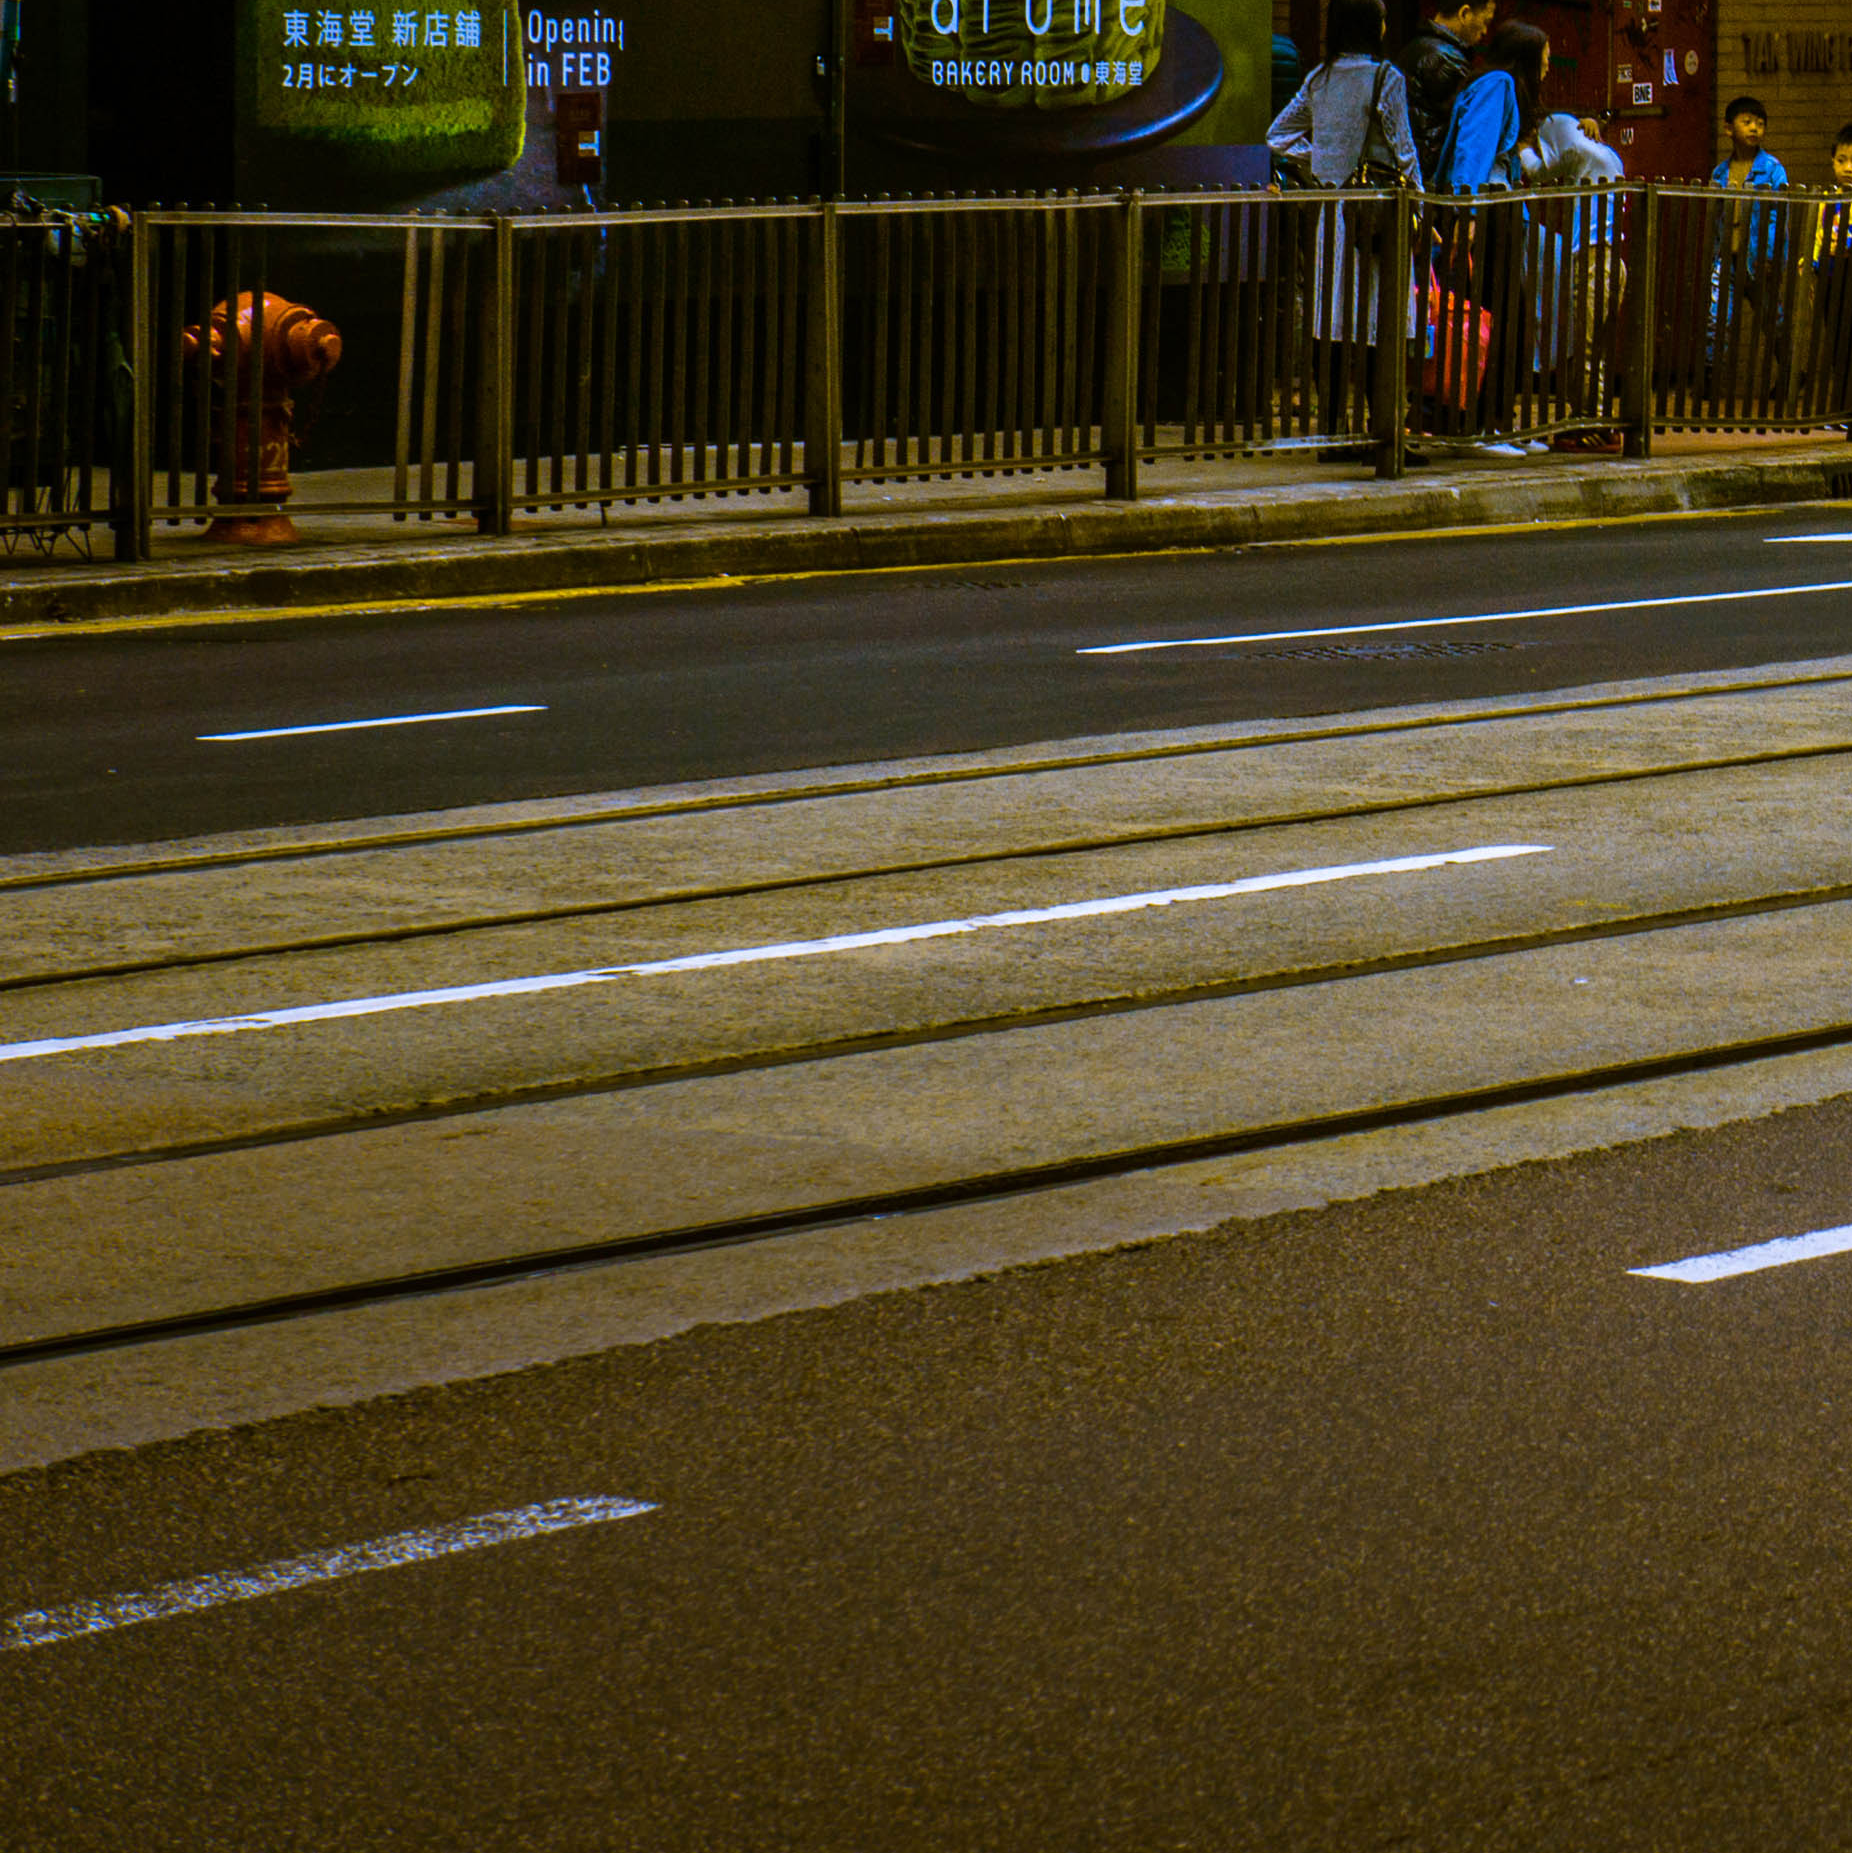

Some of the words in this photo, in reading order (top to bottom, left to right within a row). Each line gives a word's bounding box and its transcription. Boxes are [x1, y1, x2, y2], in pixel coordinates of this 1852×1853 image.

[282, 9, 377, 49] 東海堂
[281, 62, 420, 91] 2月にオープン
[527, 52, 551, 87] in
[561, 51, 613, 87] FEB
[932, 59, 1014, 86] BAKERY
[1021, 59, 1075, 86] ROOM
[1094, 60, 1144, 86] 東海堂
